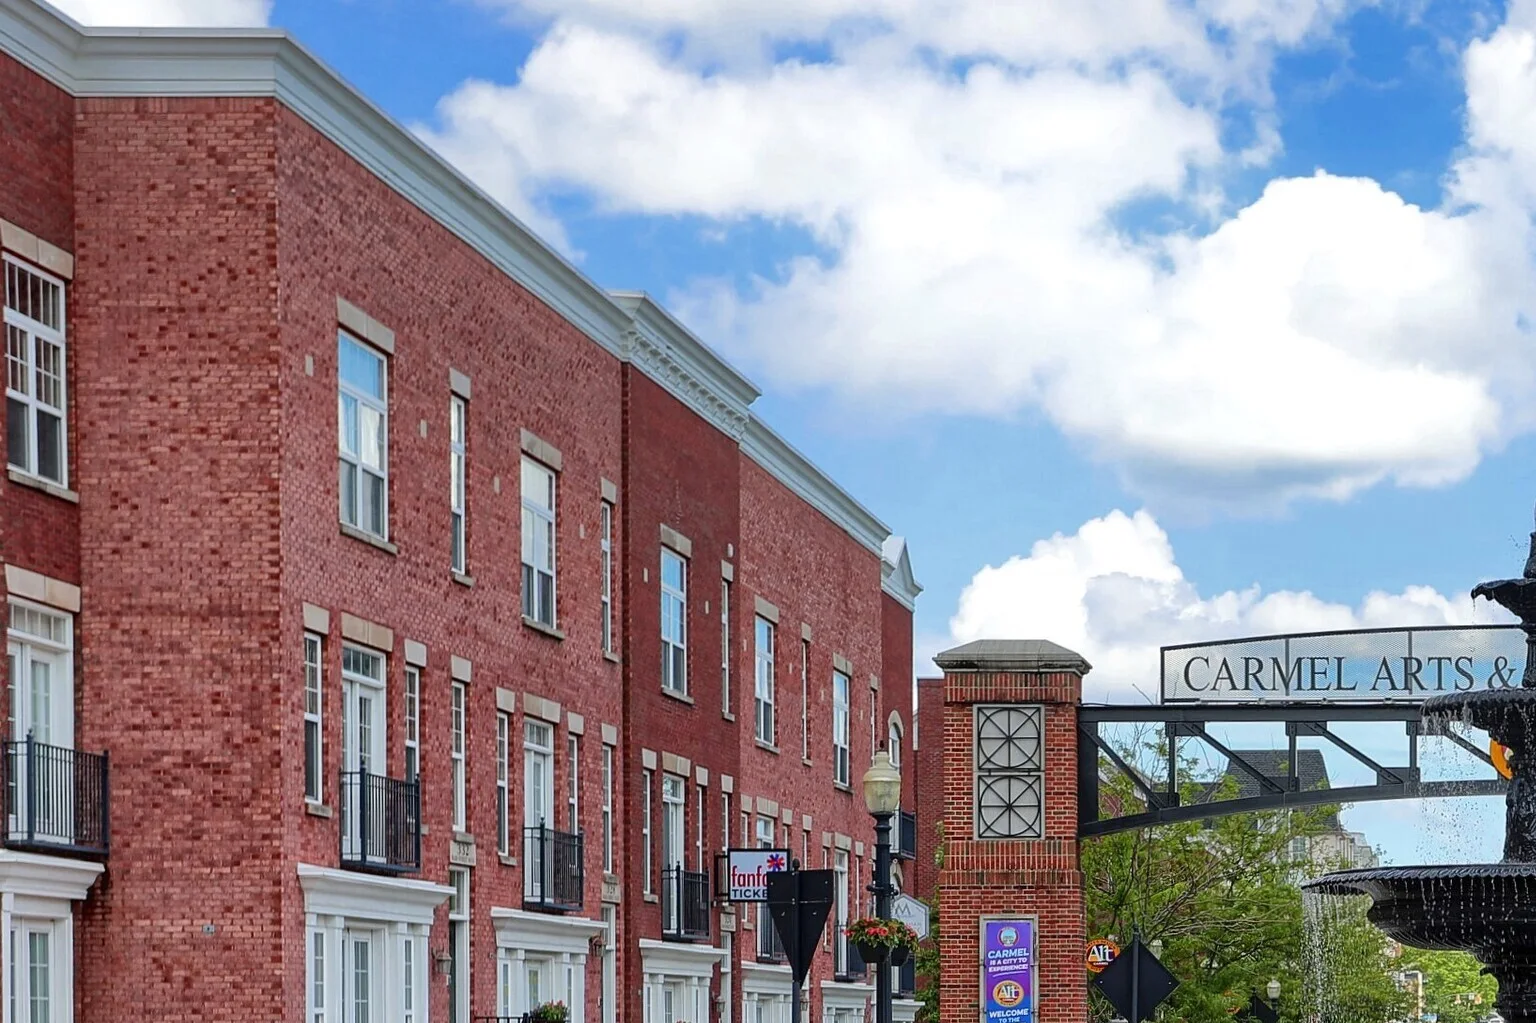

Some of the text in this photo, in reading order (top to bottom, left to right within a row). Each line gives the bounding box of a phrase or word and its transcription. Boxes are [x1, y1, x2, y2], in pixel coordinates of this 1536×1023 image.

[1184, 656, 1357, 692] CARMEL
[1370, 656, 1474, 692] ARTS
[1486, 656, 1519, 690] &
[731, 889, 767, 898] TICKE
[988, 948, 1029, 959] CARMEL
[988, 964, 1029, 973] EXPERIENCE!
[989, 1008, 1029, 1018] WELCOME
